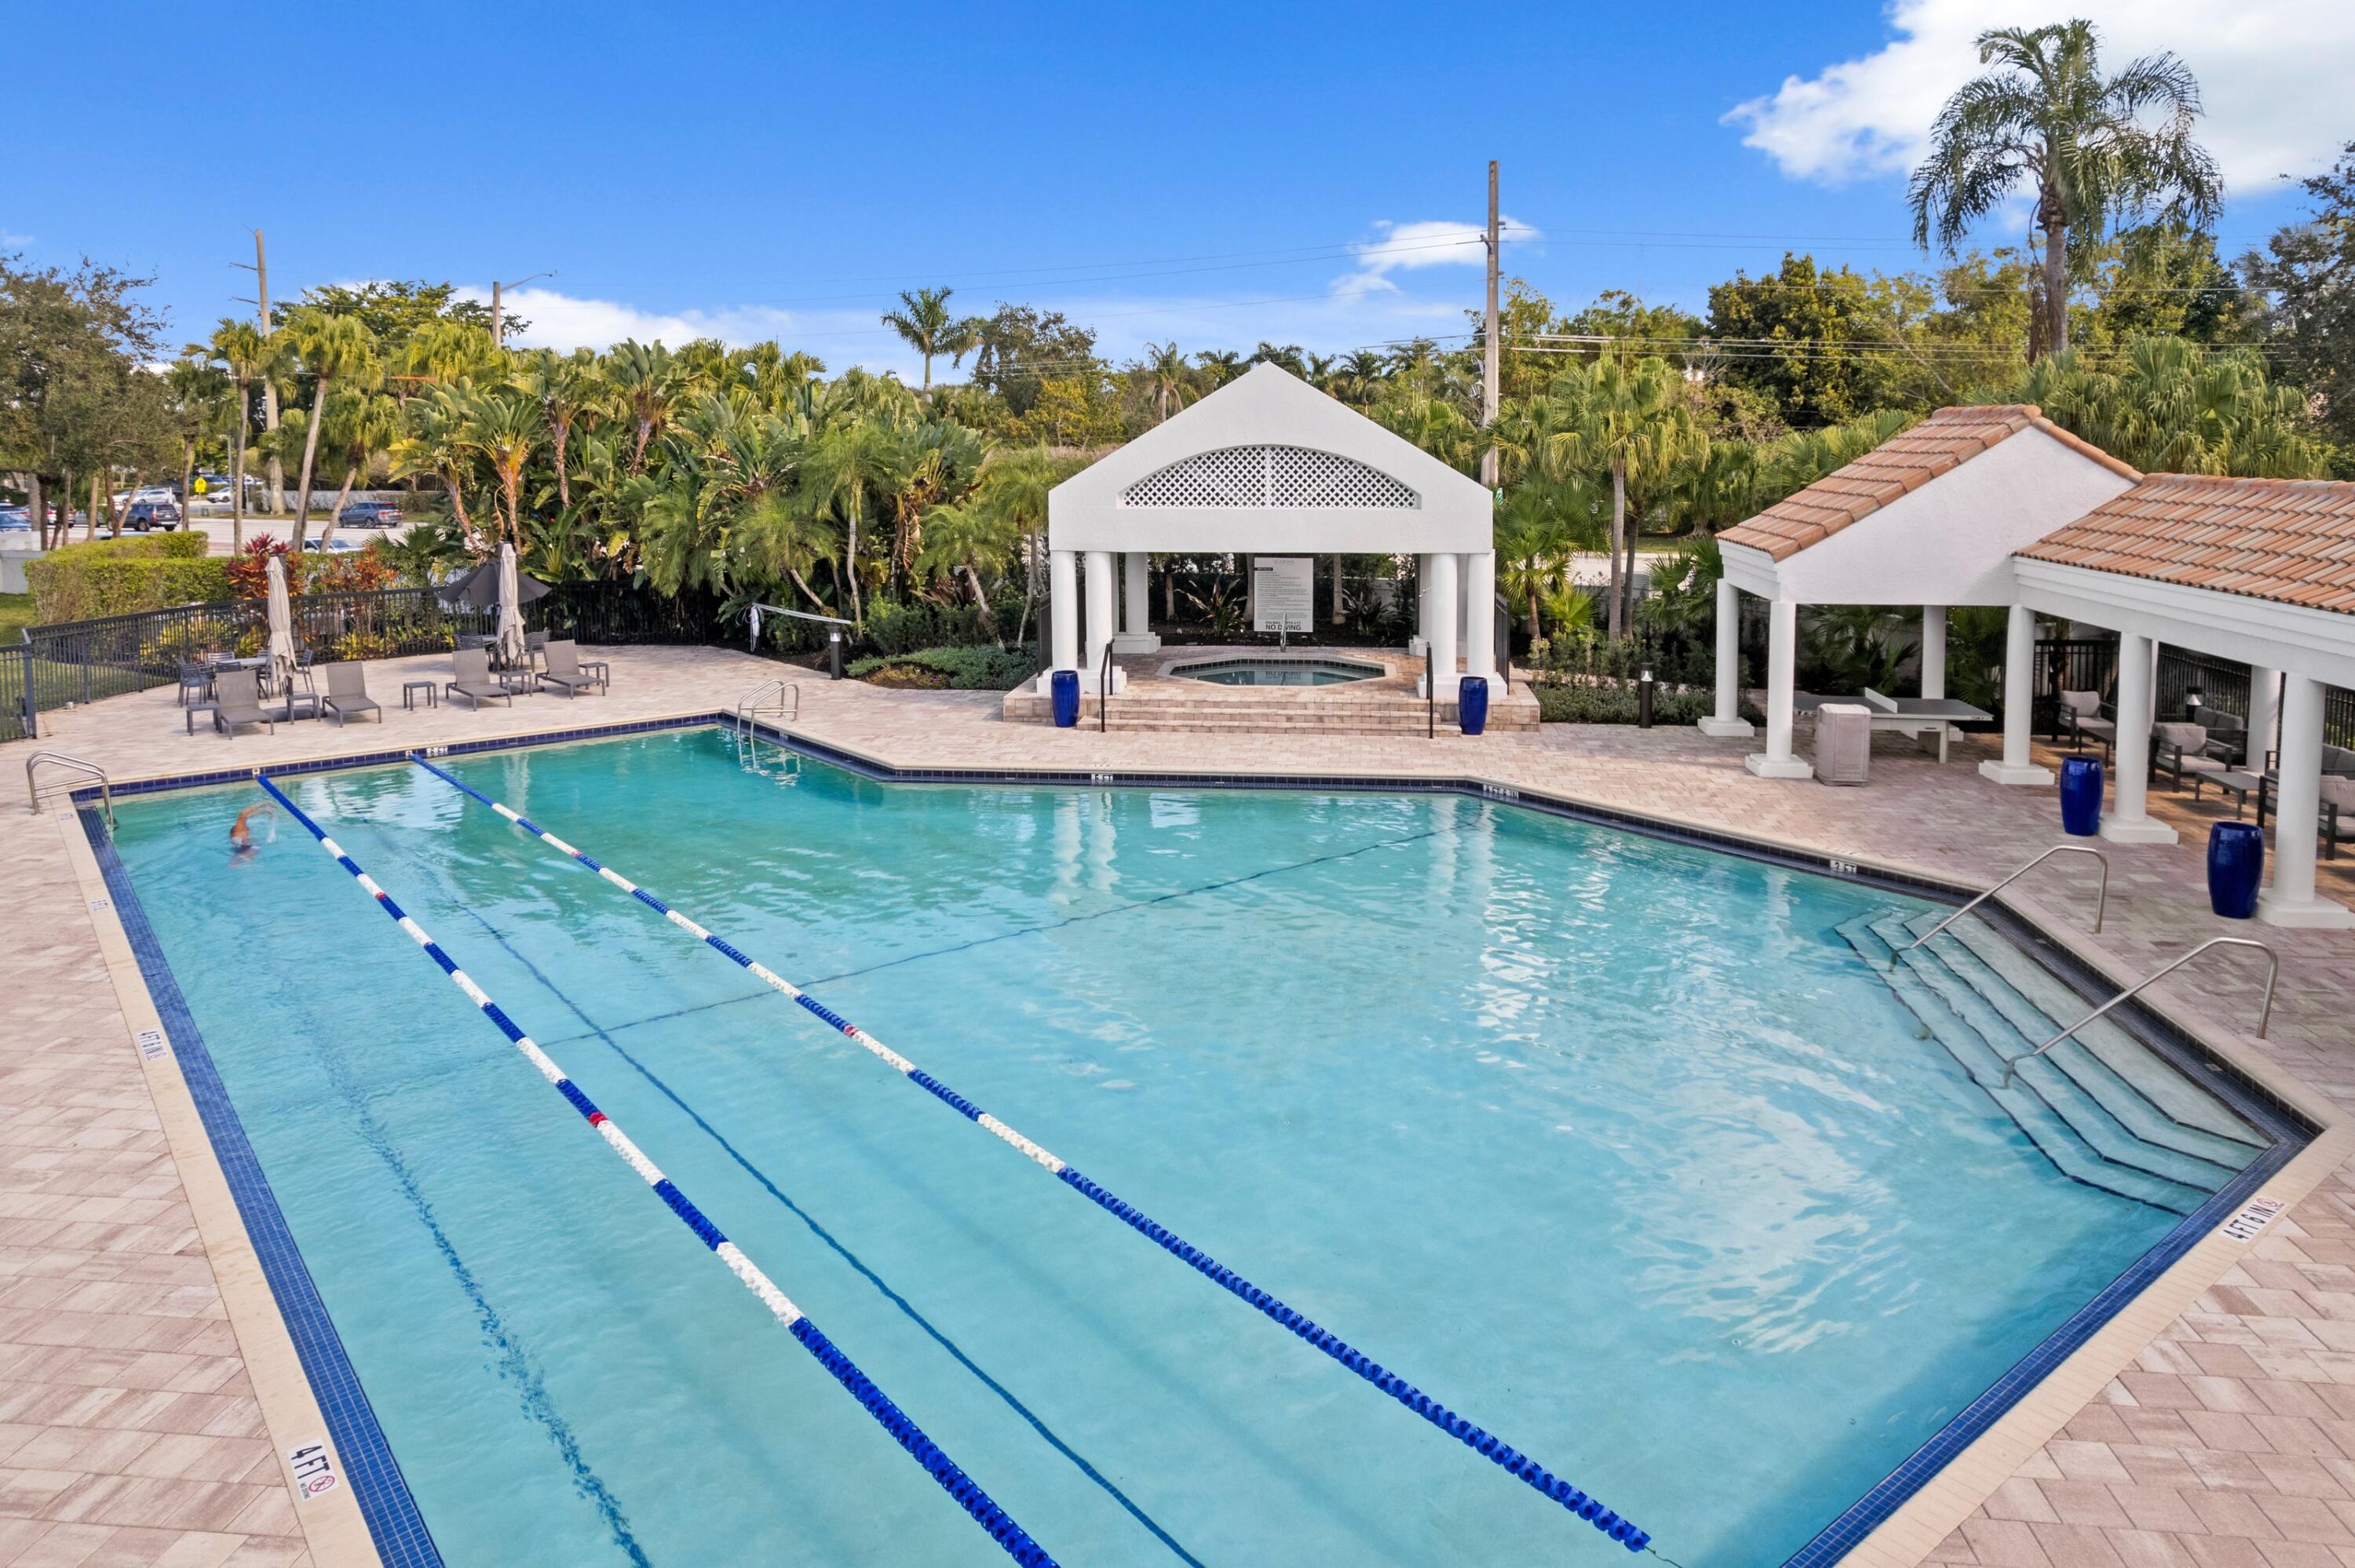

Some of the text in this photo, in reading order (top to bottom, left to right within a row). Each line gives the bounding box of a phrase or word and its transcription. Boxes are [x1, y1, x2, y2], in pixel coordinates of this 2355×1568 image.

[2247, 1204, 2276, 1218] IN
[2240, 1213, 2266, 1224] 6
[2223, 1229, 2249, 1239] 4
[2229, 1219, 2259, 1235] FT
[290, 1445, 330, 1479] 4 FT
